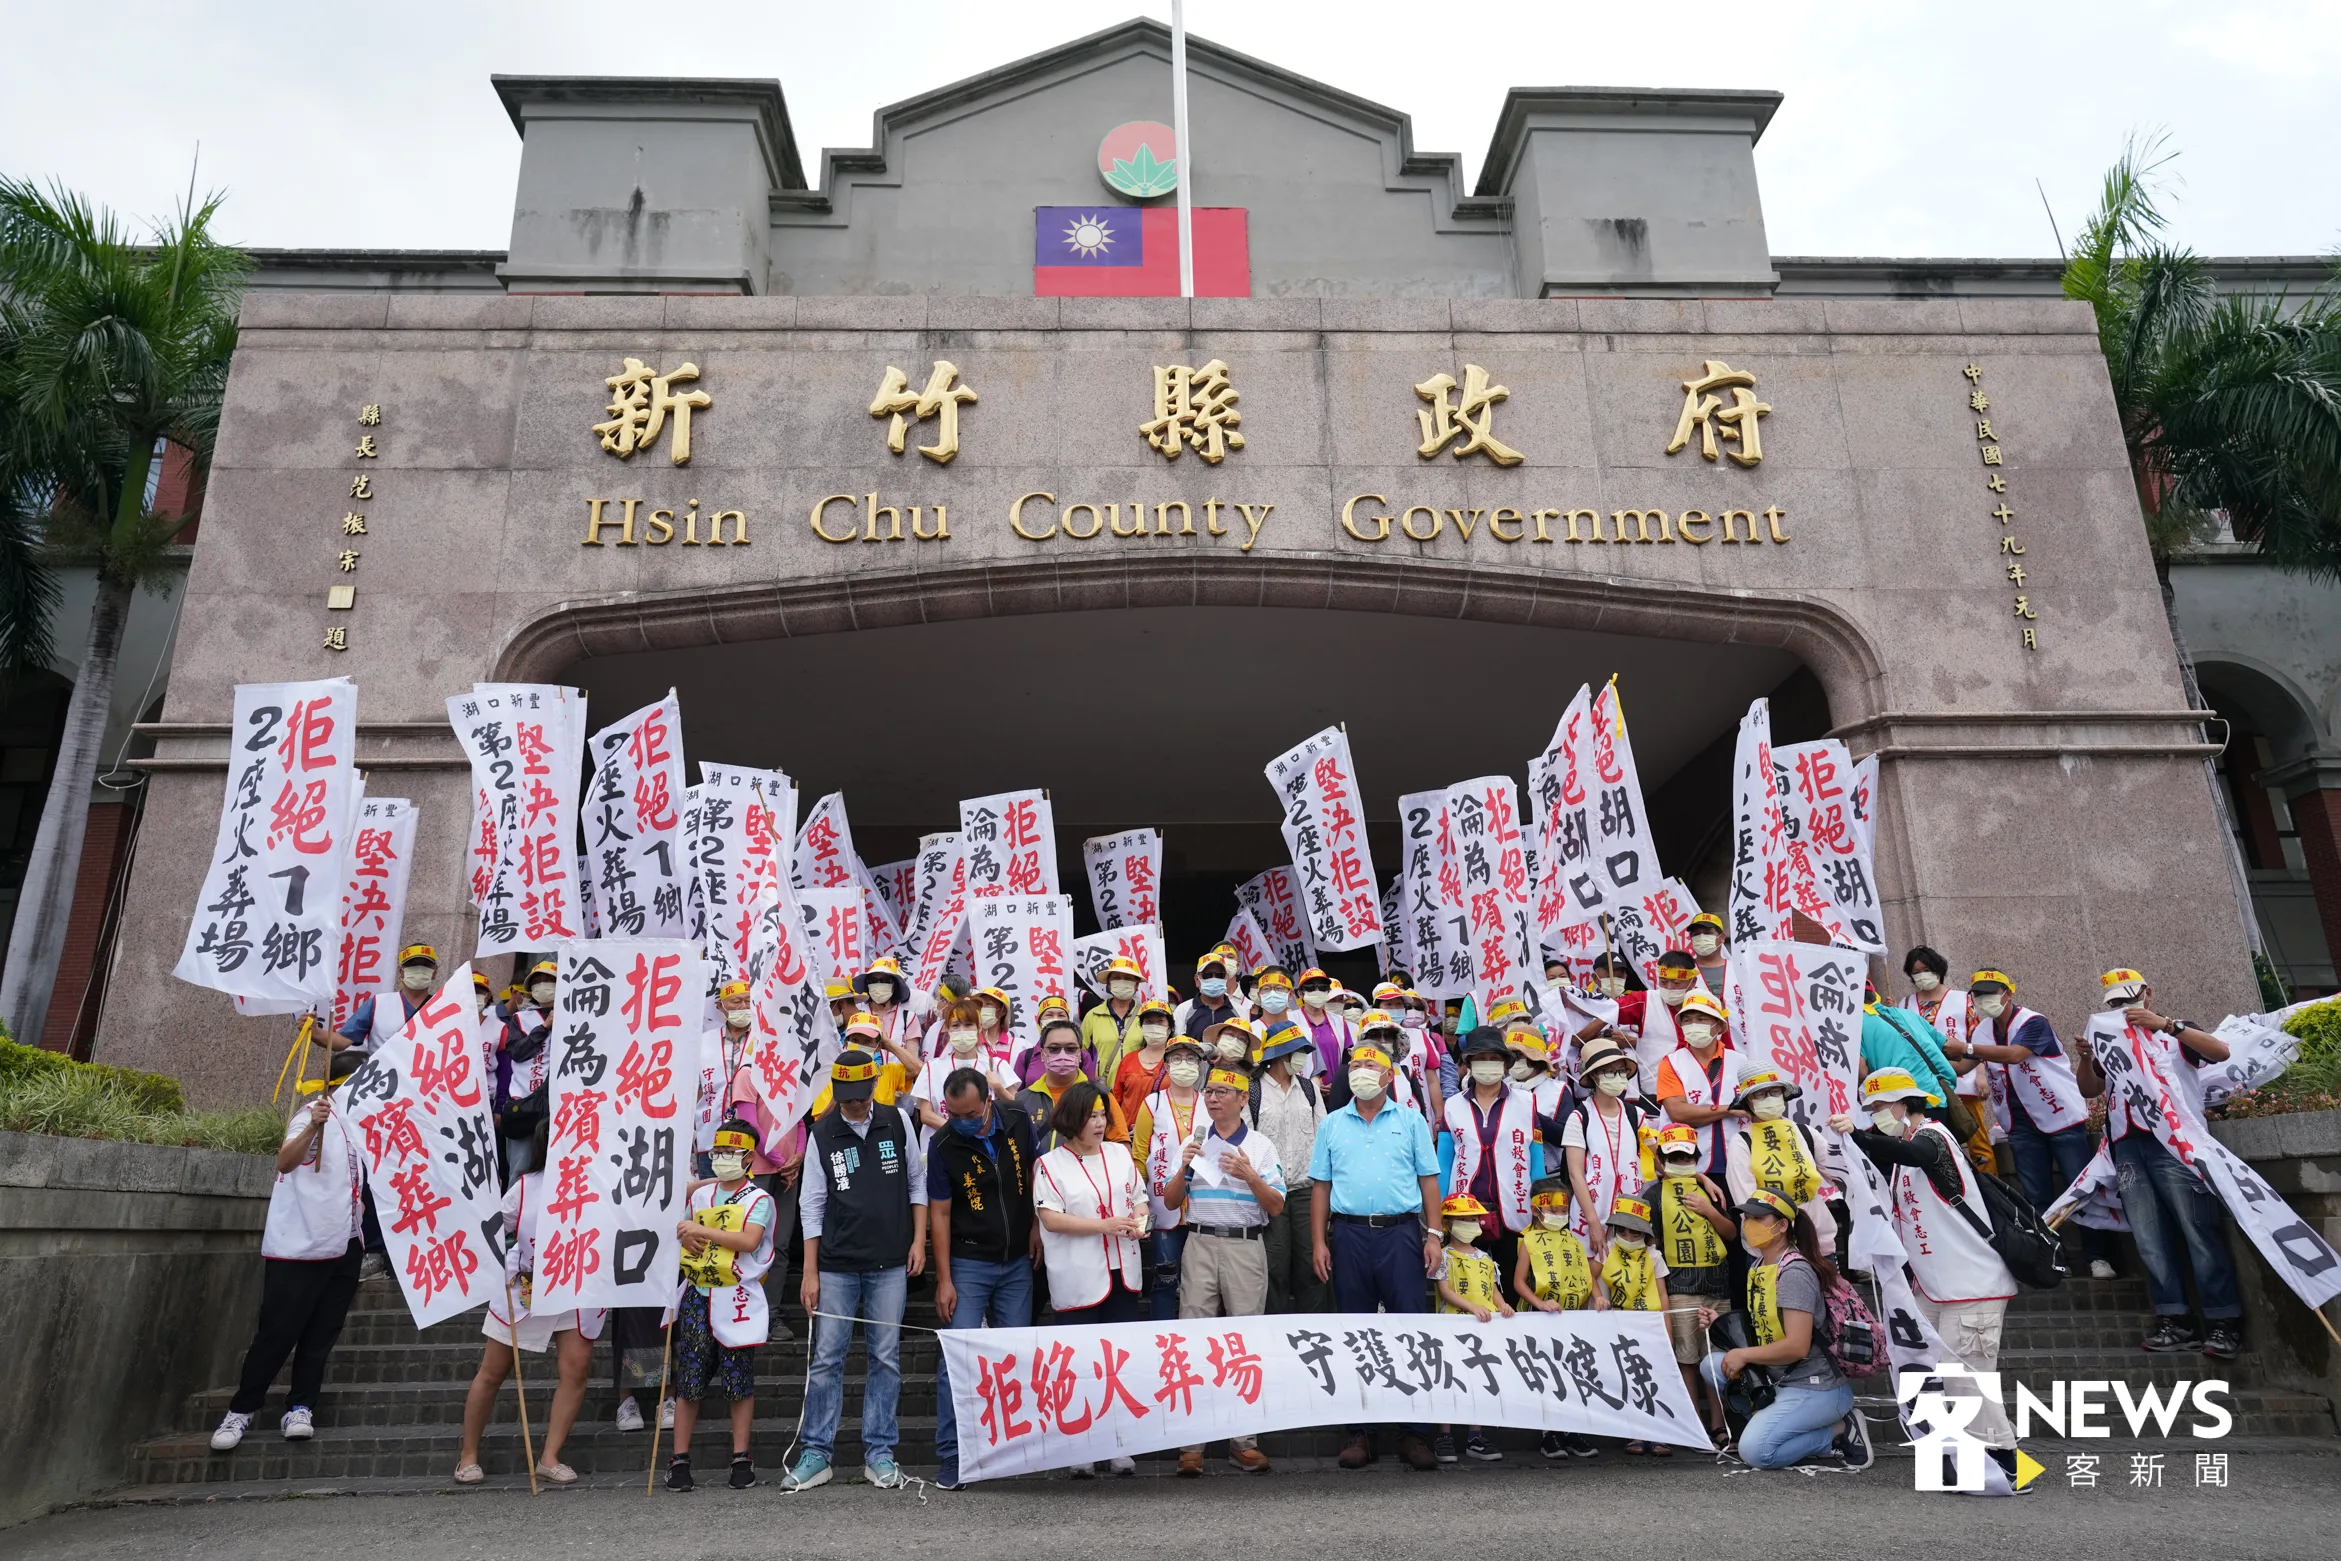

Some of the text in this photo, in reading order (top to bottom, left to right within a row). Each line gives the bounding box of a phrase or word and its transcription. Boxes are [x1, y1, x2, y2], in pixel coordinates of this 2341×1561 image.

[592, 357, 1772, 467] 新竹縣政府
[581, 492, 1791, 551] Hsin Chu County Government
[1963, 363, 2037, 650] 中華民國七十九年元月
[462, 692, 540, 719] 湖口新豐
[708, 771, 779, 797] 湖口新豐
[1275, 735, 1332, 777] 湖口新豐
[196, 706, 283, 973] 2座火葬場
[262, 695, 337, 982] 拒絕1鄉
[516, 721, 576, 941] 堅決拒設
[589, 732, 647, 935] 2座火葬場
[628, 707, 685, 928] 拒絕1鄉
[1003, 798, 1047, 896] 拒絕
[1092, 834, 1146, 854] 湖口新豐
[1286, 772, 1343, 944] 第2座火葬場
[1314, 757, 1381, 938] 堅決拒設
[984, 902, 1057, 917] 湖口新豐
[1408, 808, 1444, 987] 2座火葬場
[1509, 1002, 1520, 1011] 抗
[1659, 967, 1688, 979] 抗議
[838, 1064, 873, 1079] 抗議
[1512, 1033, 1524, 1043] 議
[542, 956, 616, 1297] 淪為殯葬鄉
[612, 952, 683, 1286] 拒絕湖口
[1153, 1132, 1169, 1196] 守護家園
[1512, 1128, 1528, 1214] 自救會志工
[1903, 1174, 1932, 1256] 自救會志工
[975, 1327, 1675, 1446] 拒絕火葬場 守護孩子的健康
